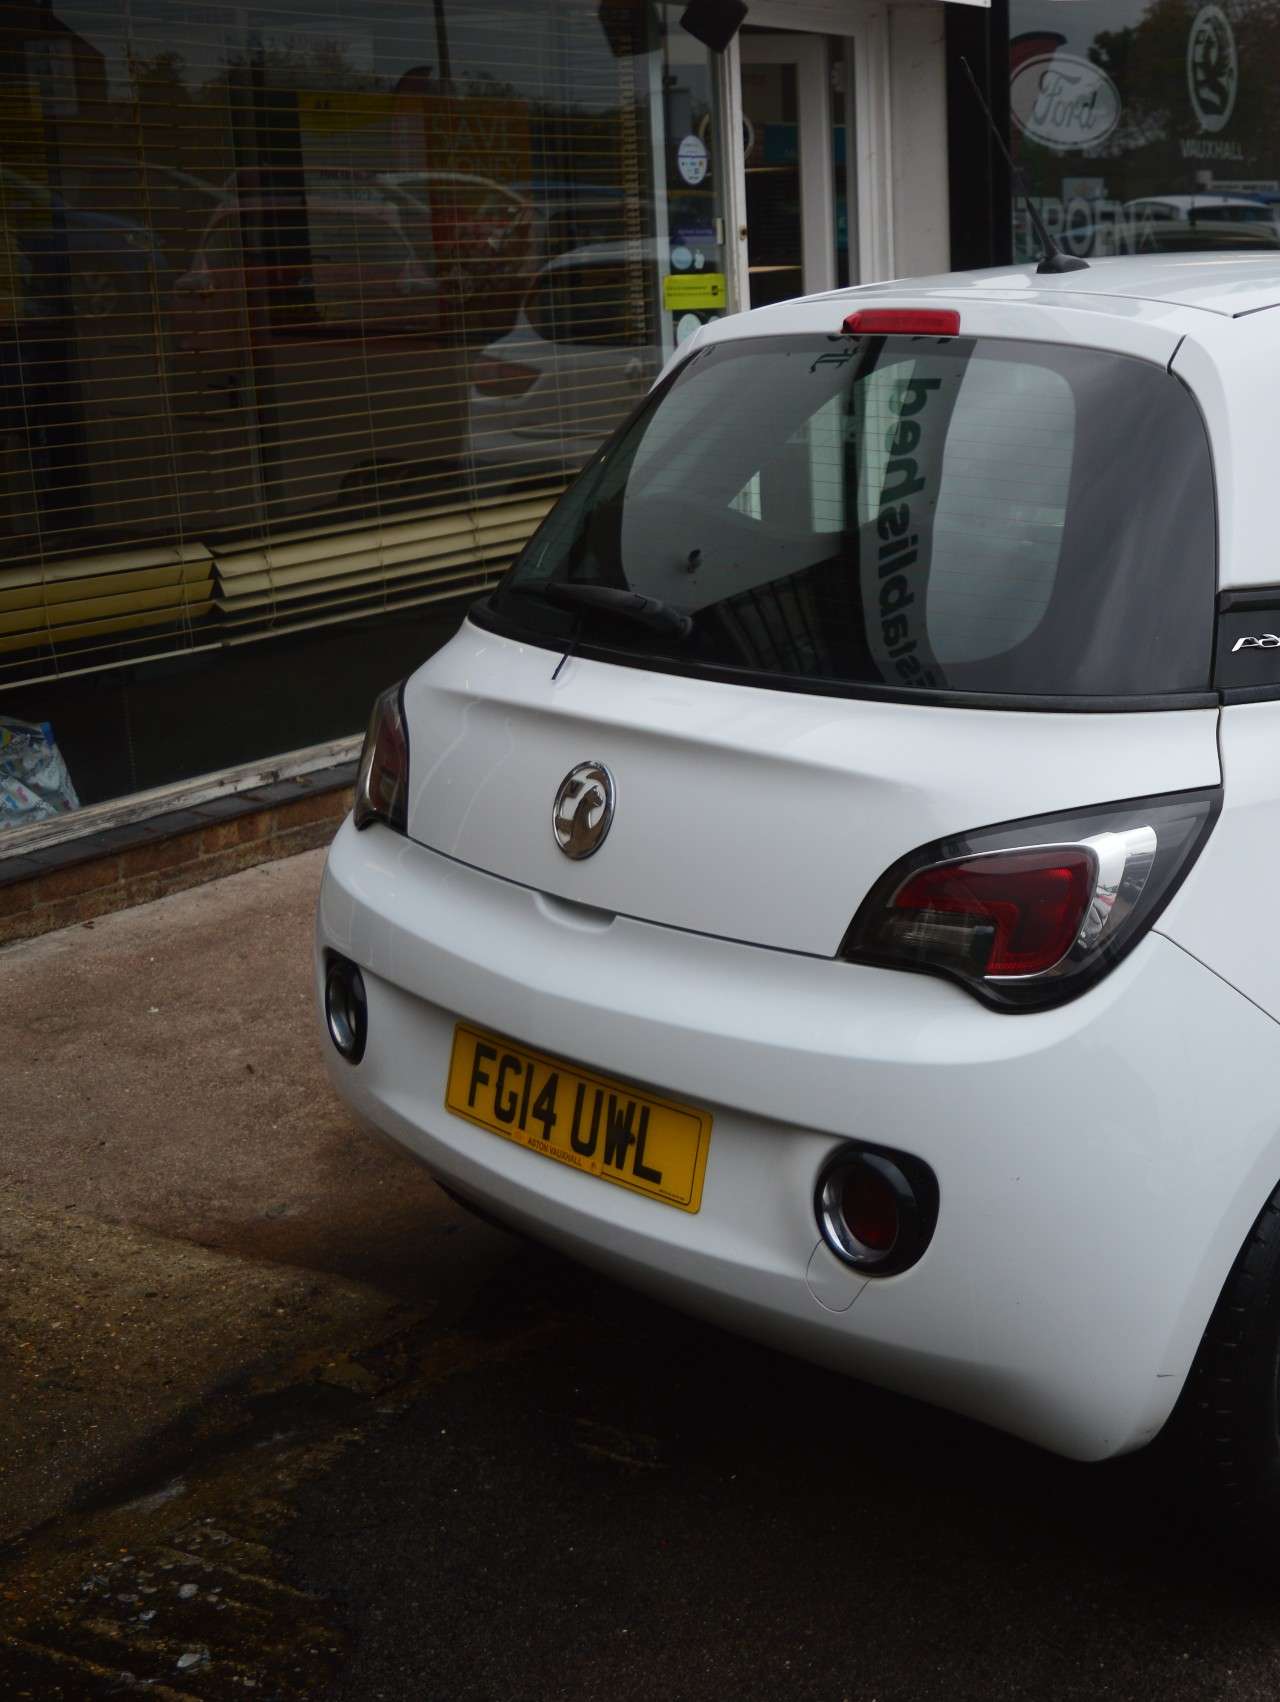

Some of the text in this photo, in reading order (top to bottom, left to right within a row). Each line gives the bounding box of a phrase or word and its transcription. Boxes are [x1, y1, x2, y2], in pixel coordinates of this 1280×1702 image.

[1028, 70, 1098, 129] Ford
[1180, 138, 1244, 161] VAUXHALL
[467, 1041, 663, 1185] FG14 UWL
[527, 1137, 583, 1168] ASTON VAUXHALL
